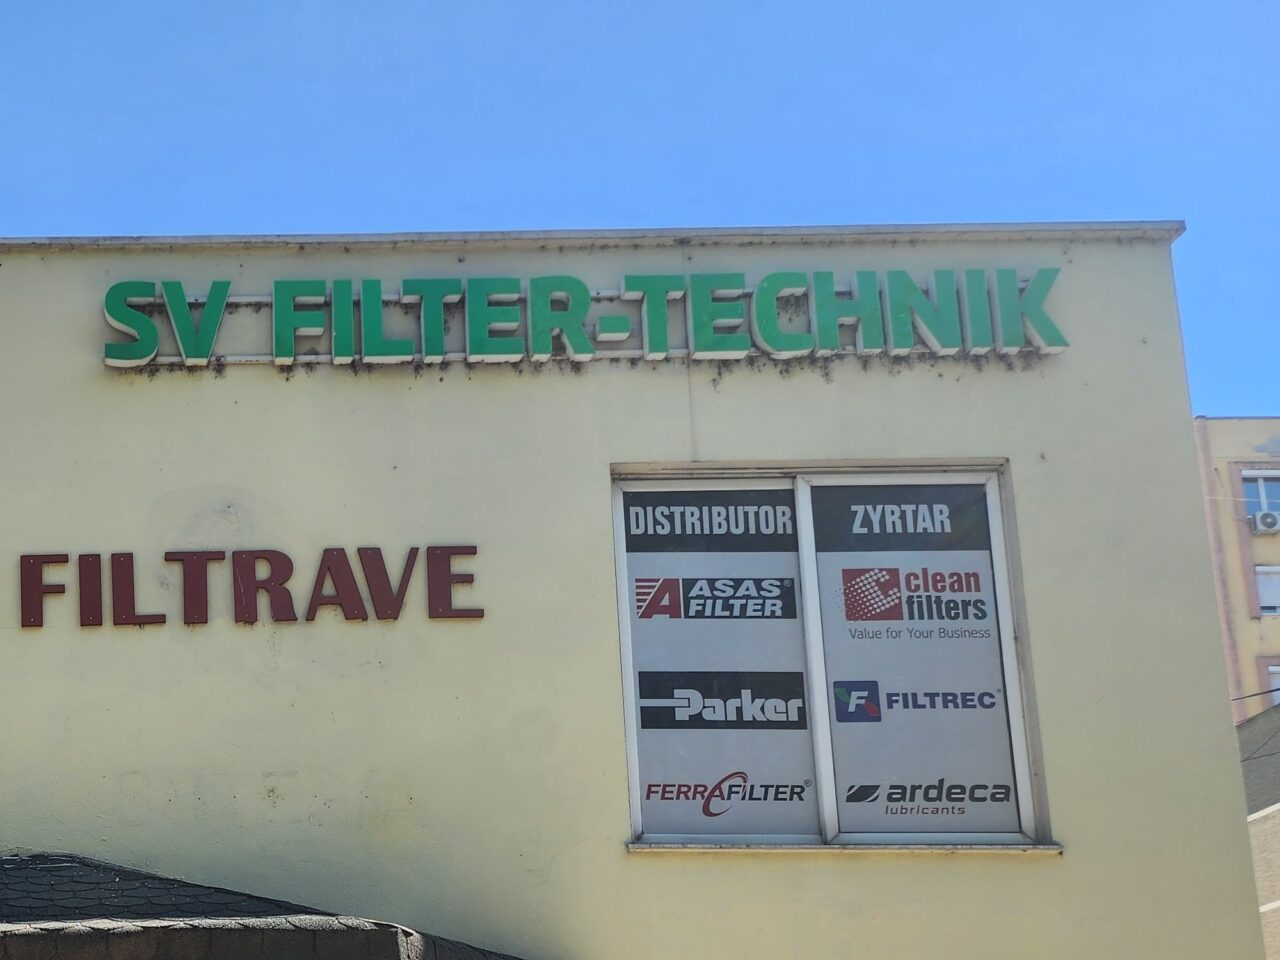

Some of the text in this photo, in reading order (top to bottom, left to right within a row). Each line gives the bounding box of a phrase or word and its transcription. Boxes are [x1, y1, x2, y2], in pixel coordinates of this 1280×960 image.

[104, 268, 1070, 367] SV FILTER-TECHNIK
[630, 505, 792, 535] DISTRIBUTOR
[851, 504, 951, 534] ZYRTAR
[20, 545, 484, 626] FILTRAVE
[688, 580, 781, 597] ASAS
[905, 568, 980, 593] clean
[688, 600, 783, 617] FILTER
[906, 595, 987, 620] filters
[849, 628, 990, 639] Value for Your Business
[674, 689, 803, 721] Parker
[886, 692, 996, 709] FILTREC
[886, 778, 1010, 802] ardeca
[885, 805, 965, 815] lubricants
